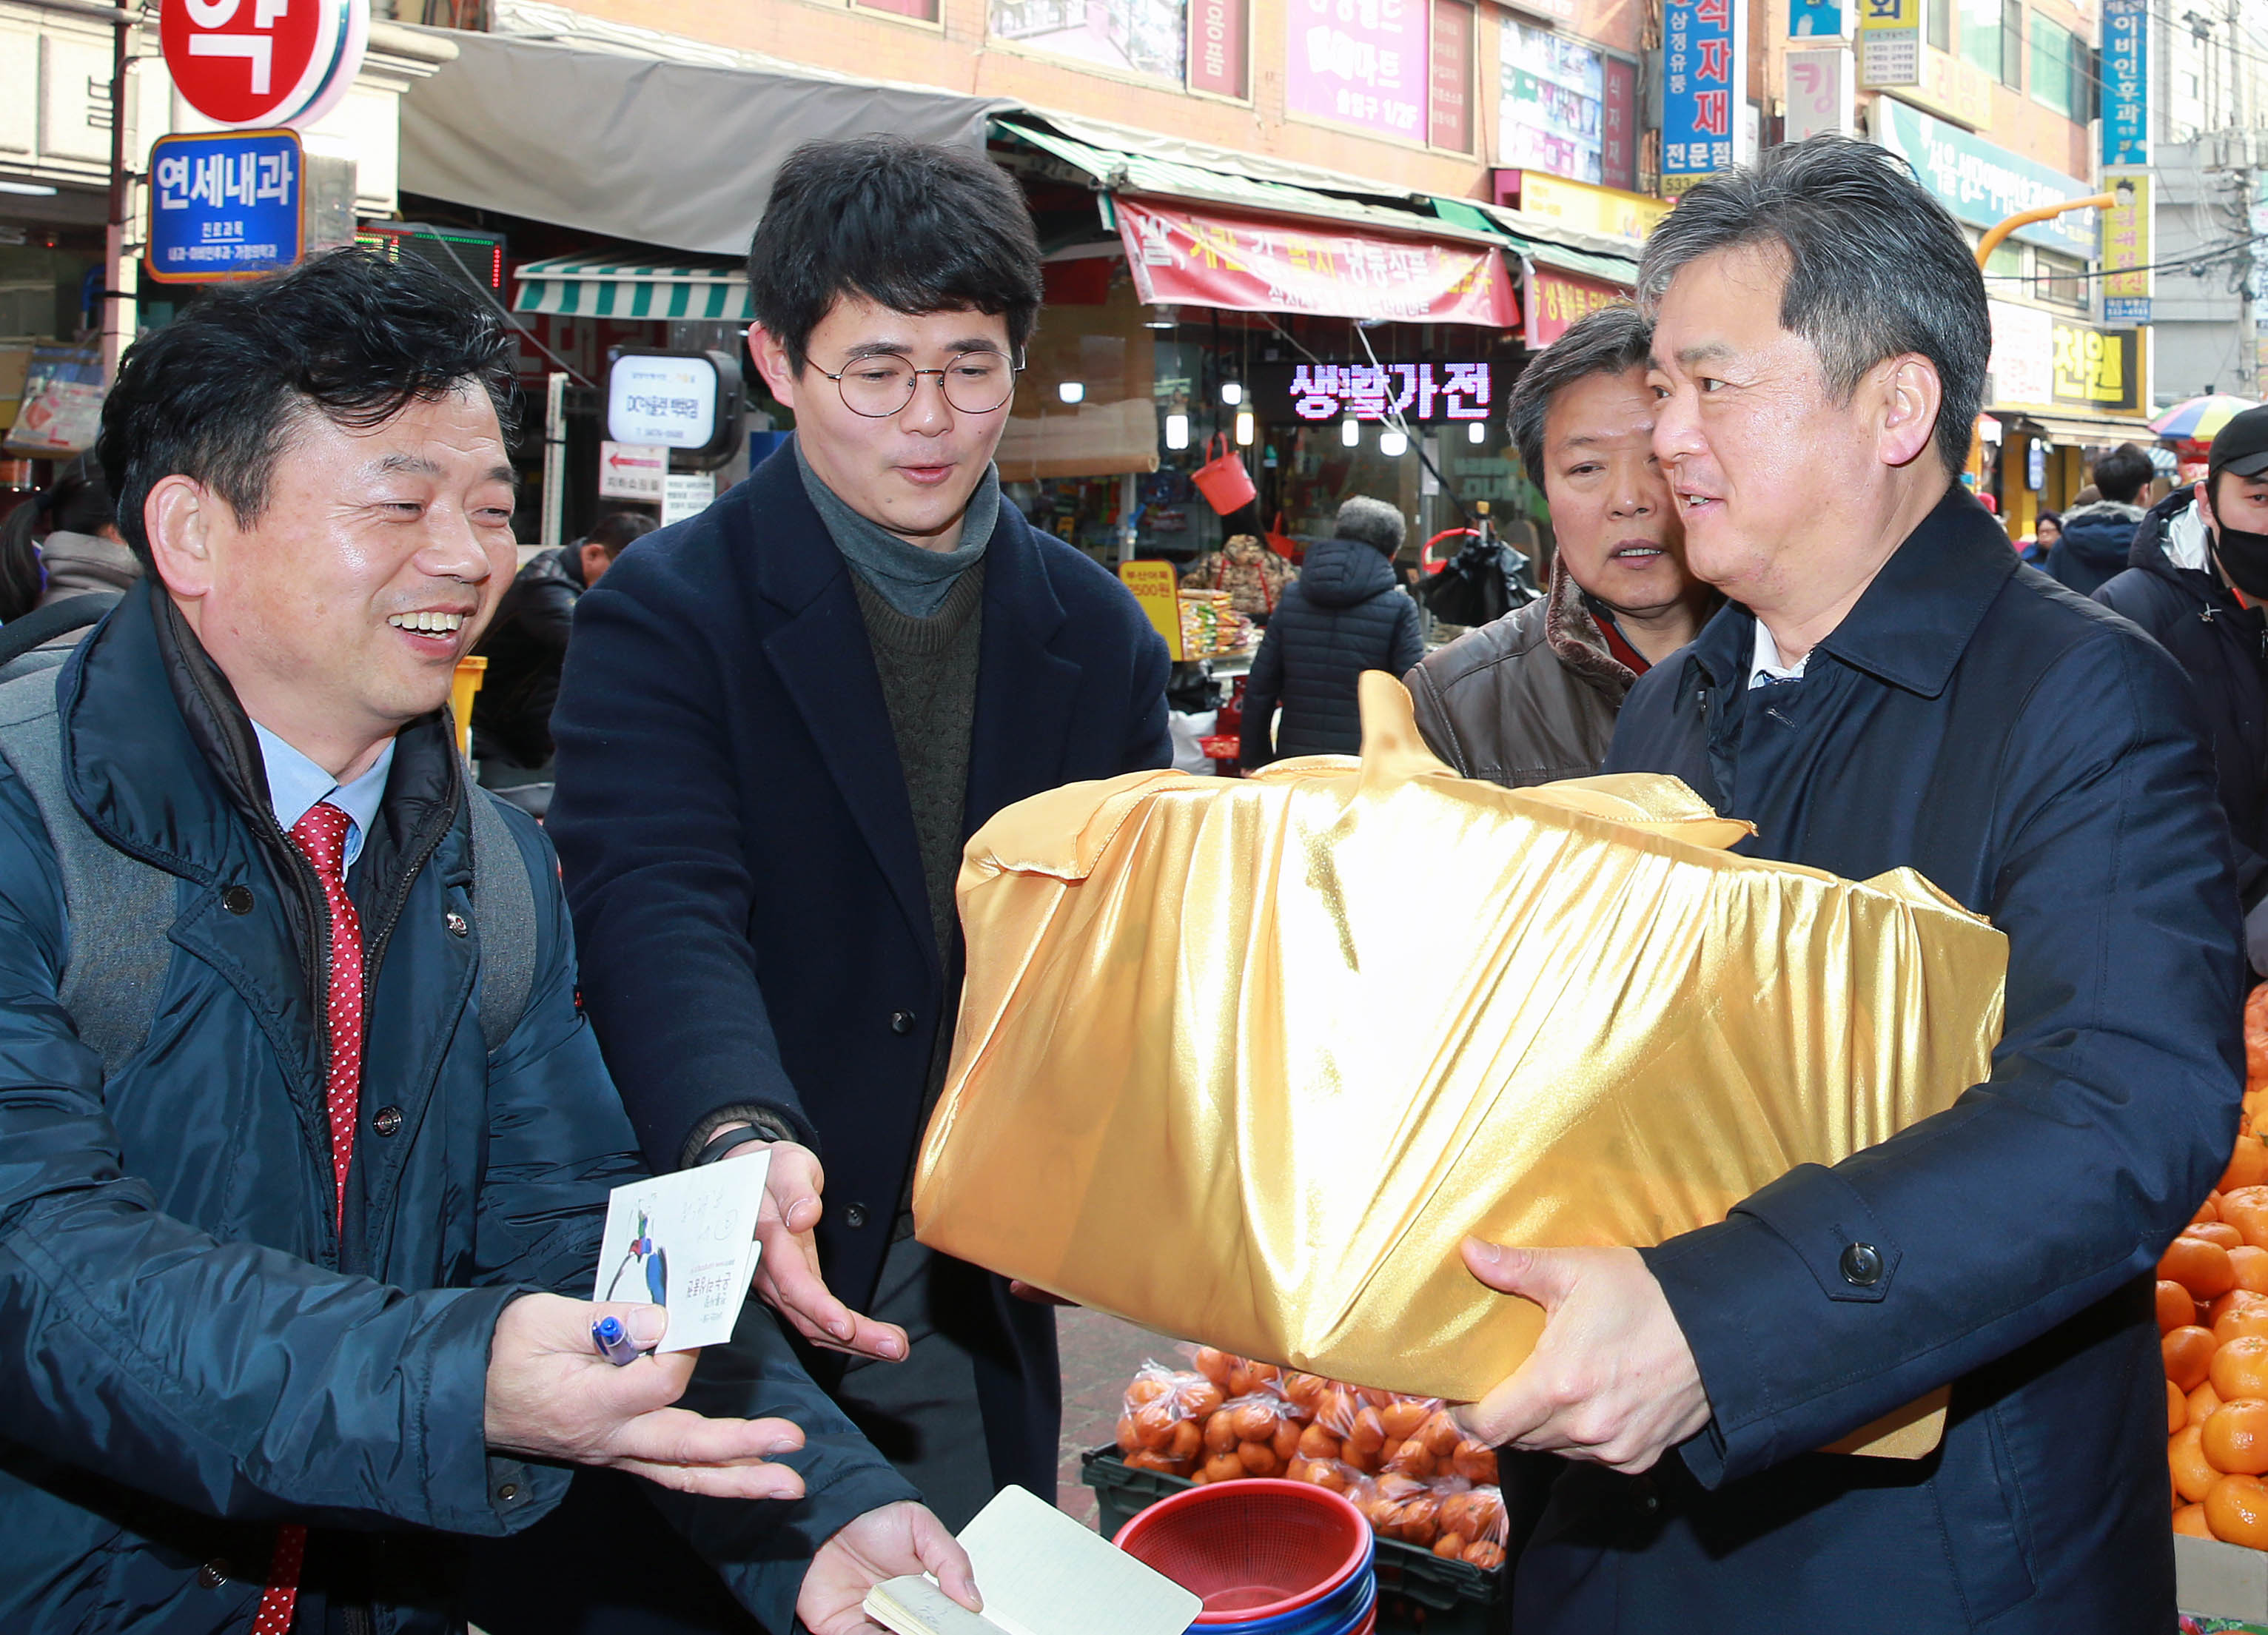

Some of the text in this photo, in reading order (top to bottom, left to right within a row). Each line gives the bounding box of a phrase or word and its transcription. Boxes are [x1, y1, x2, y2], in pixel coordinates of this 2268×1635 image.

[1669, 11, 1689, 95] 삼정유통
[2113, 16, 2141, 125] 이비인후과
[1791, 62, 1836, 113] 킹
[157, 150, 294, 210] 연세내과
[1666, 141, 1731, 169] 전문점
[1289, 363, 1491, 420] 생활가전
[2053, 325, 2124, 402] 천원
